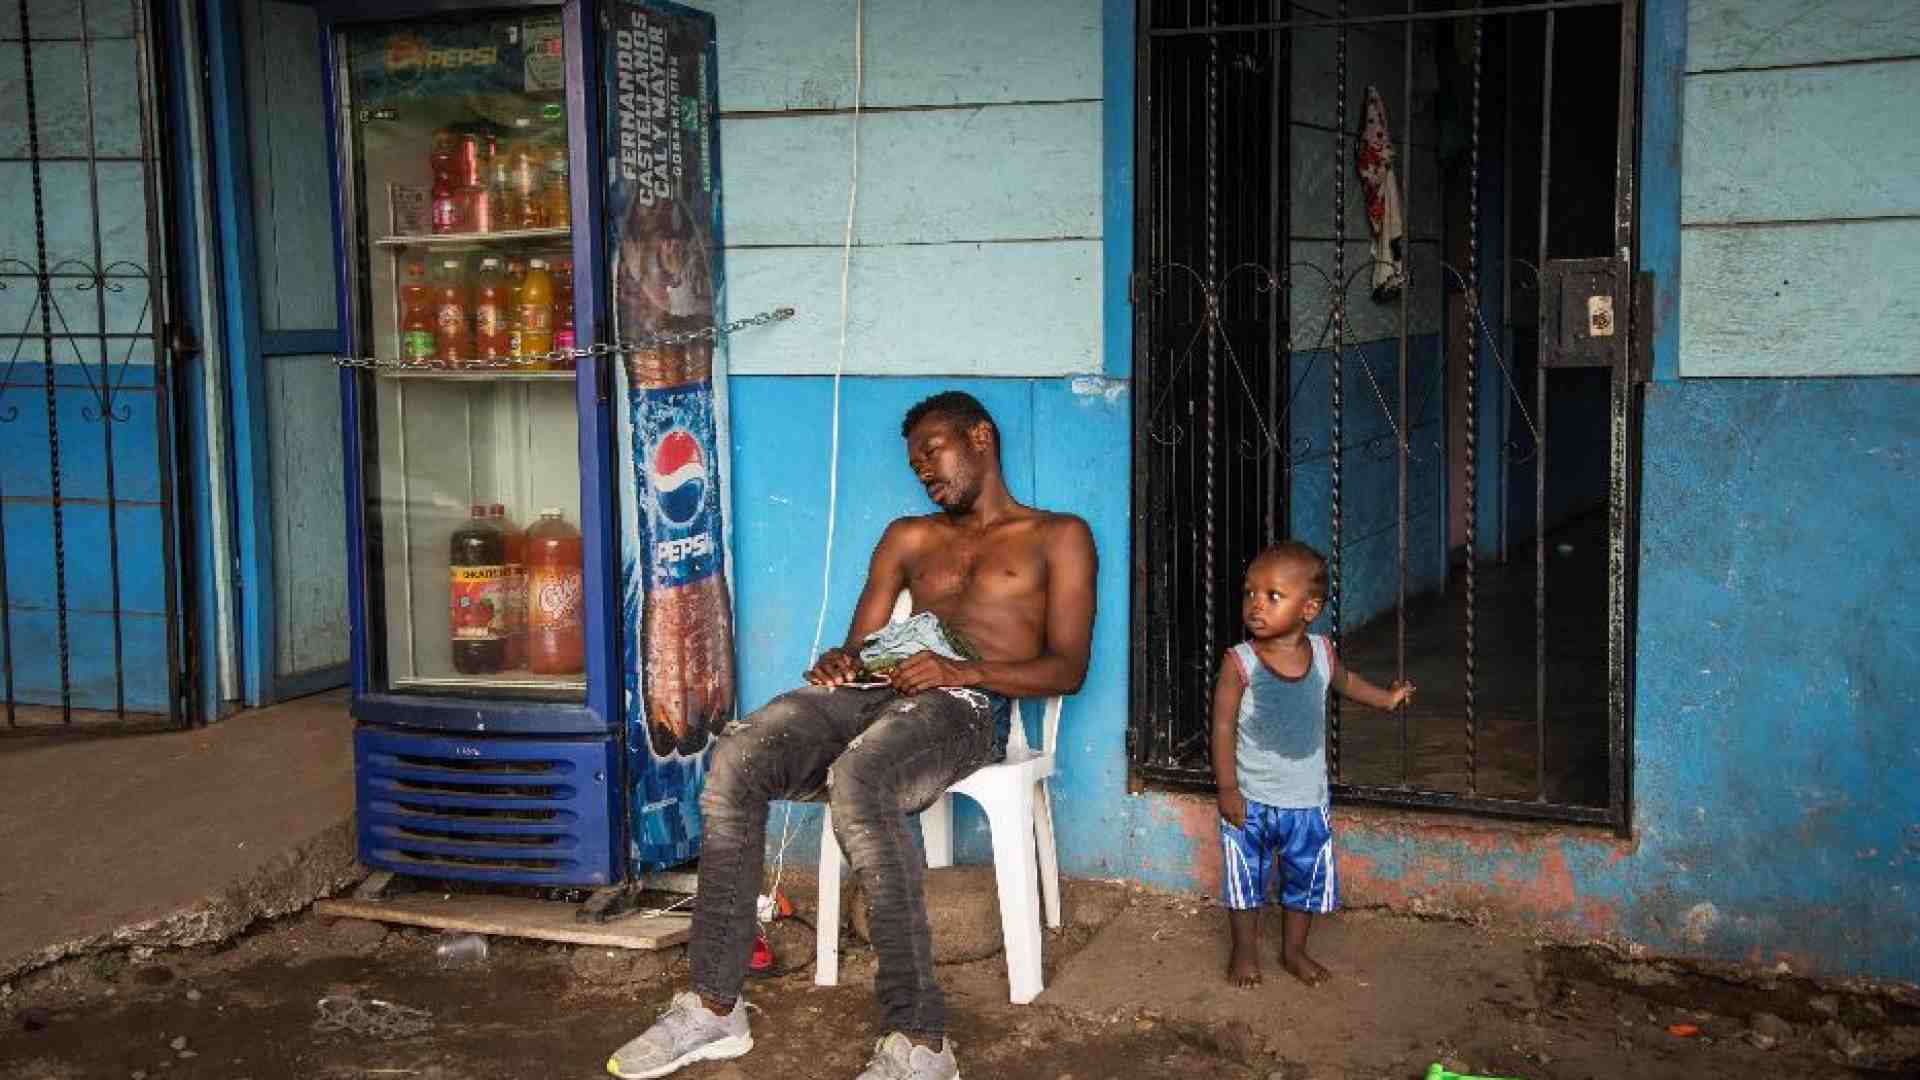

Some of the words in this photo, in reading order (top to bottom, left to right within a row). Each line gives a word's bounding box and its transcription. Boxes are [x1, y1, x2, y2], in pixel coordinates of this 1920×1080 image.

[424, 48, 494, 68] PEPSI
[649, 26, 667, 119] MAYOR
[617, 30, 637, 180] FERNANDO
[632, 12, 654, 208] CASTELLANOS
[652, 124, 668, 141] Y
[654, 146, 670, 199] CAL
[655, 533, 712, 562] PEPSI
